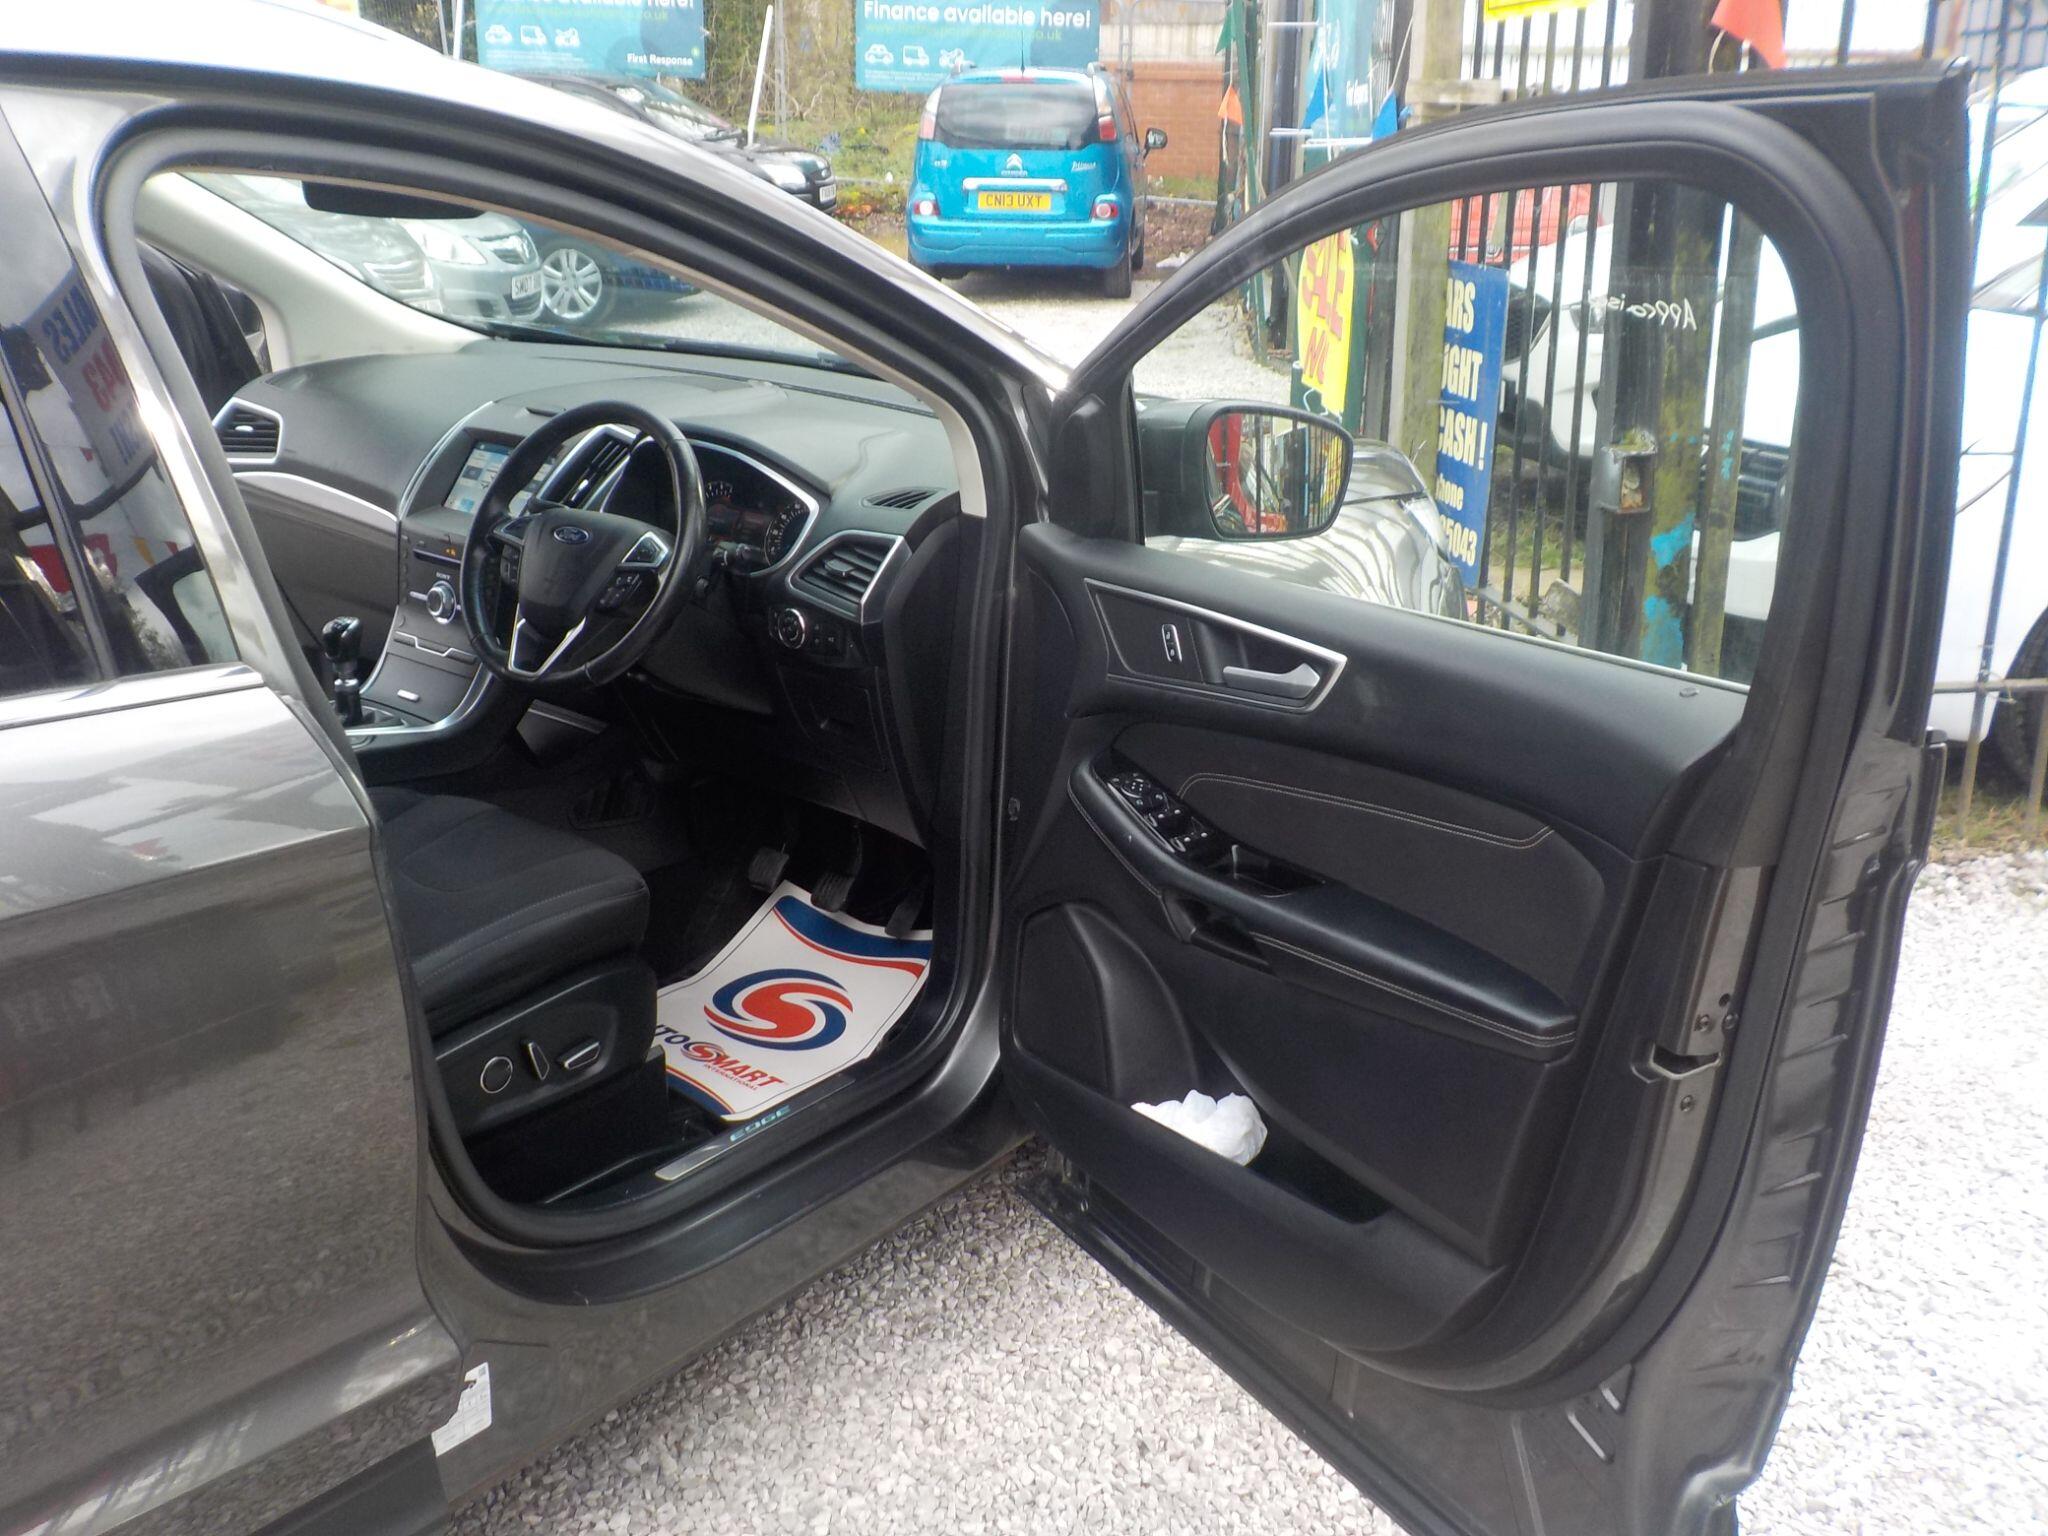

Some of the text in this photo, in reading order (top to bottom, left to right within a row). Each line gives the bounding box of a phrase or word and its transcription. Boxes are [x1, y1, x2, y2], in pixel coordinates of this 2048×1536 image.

[864, 3, 1091, 28] Finance available here!
[627, 53, 693, 67] First Response
[985, 193, 1043, 208] CN13 UXT
[729, 1104, 791, 1142] EDGE
